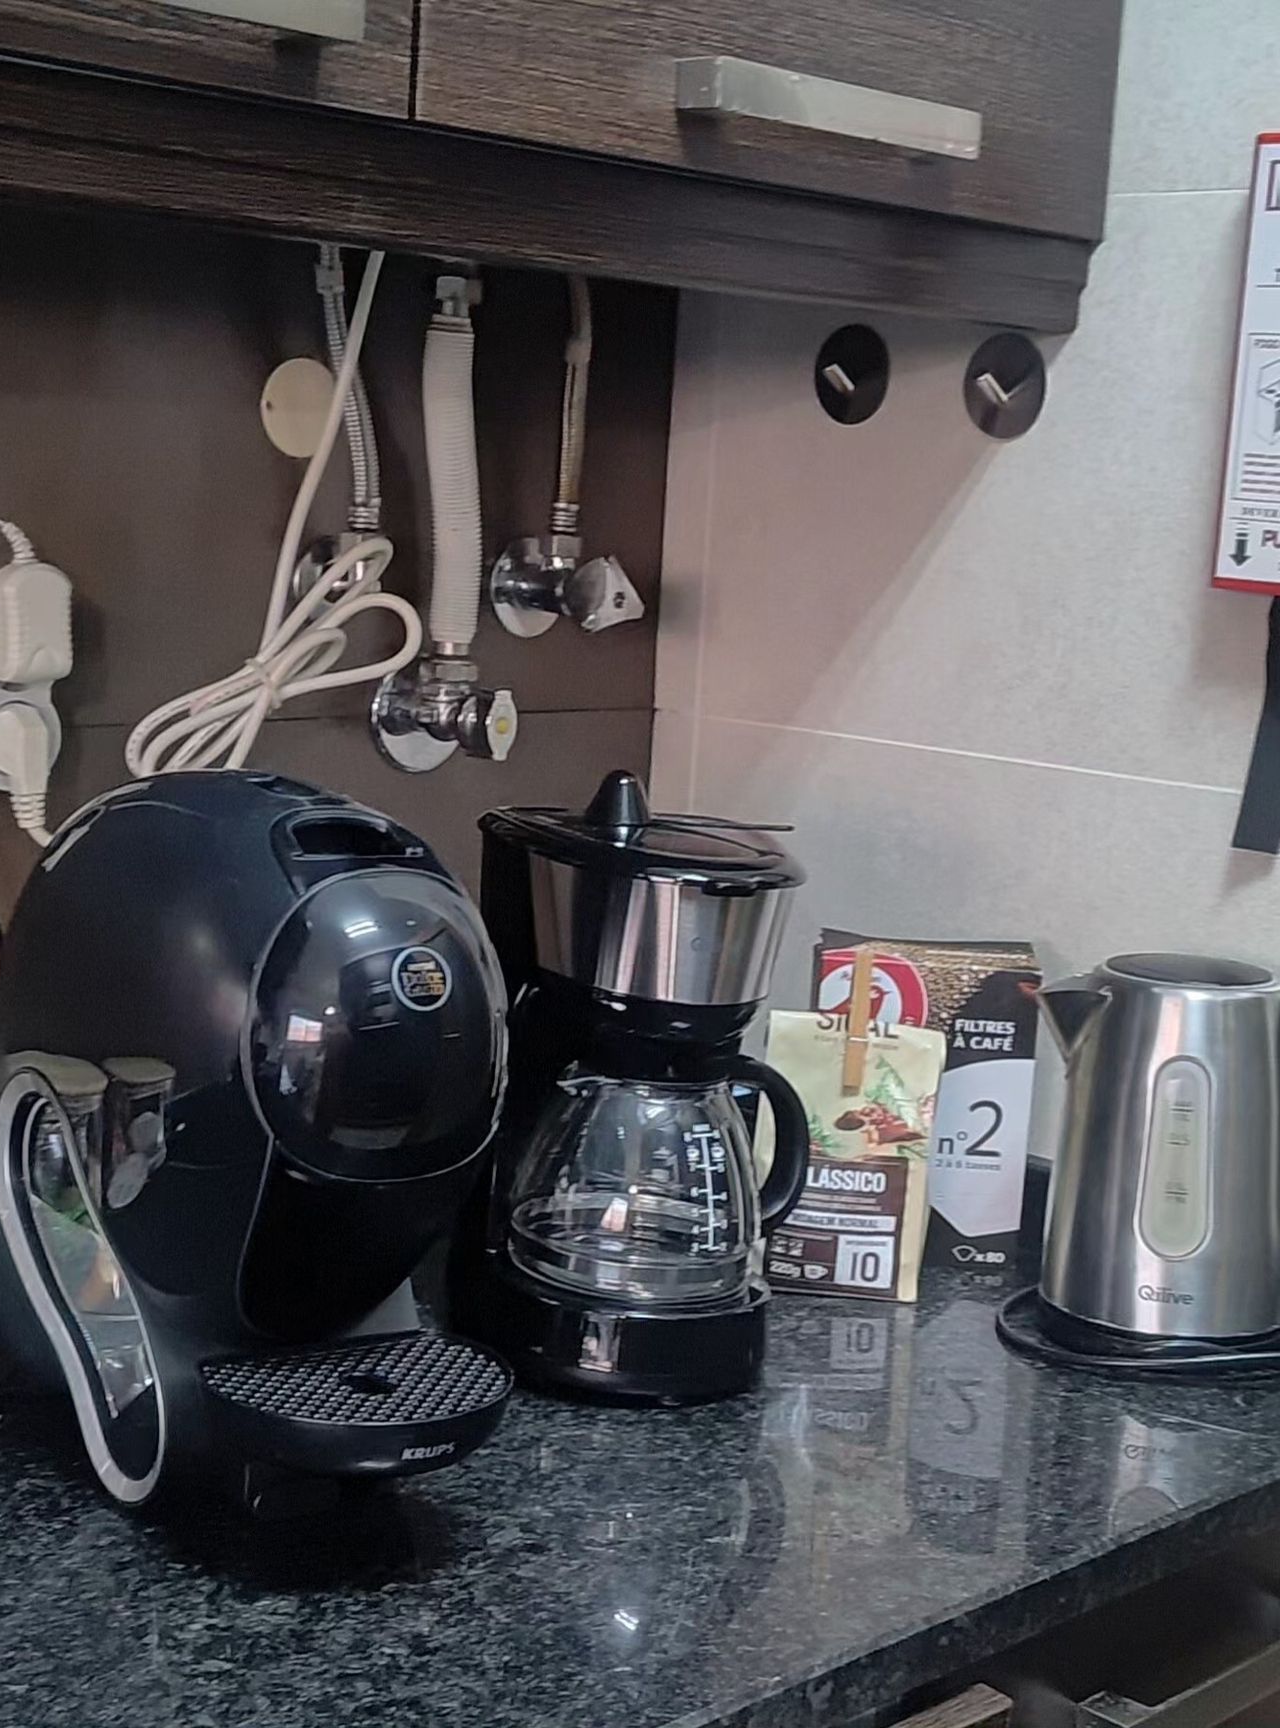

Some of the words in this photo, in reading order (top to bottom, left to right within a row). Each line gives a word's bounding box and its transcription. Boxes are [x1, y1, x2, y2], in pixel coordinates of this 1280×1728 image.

[954, 1018, 1016, 1034] FILTRES
[953, 1032, 966, 1049] À
[969, 1036, 1014, 1051] CAFÉ
[805, 1164, 887, 1193] LÁSSICO
[850, 1251, 880, 1282] 10
[401, 1441, 456, 1460] KRUPS
